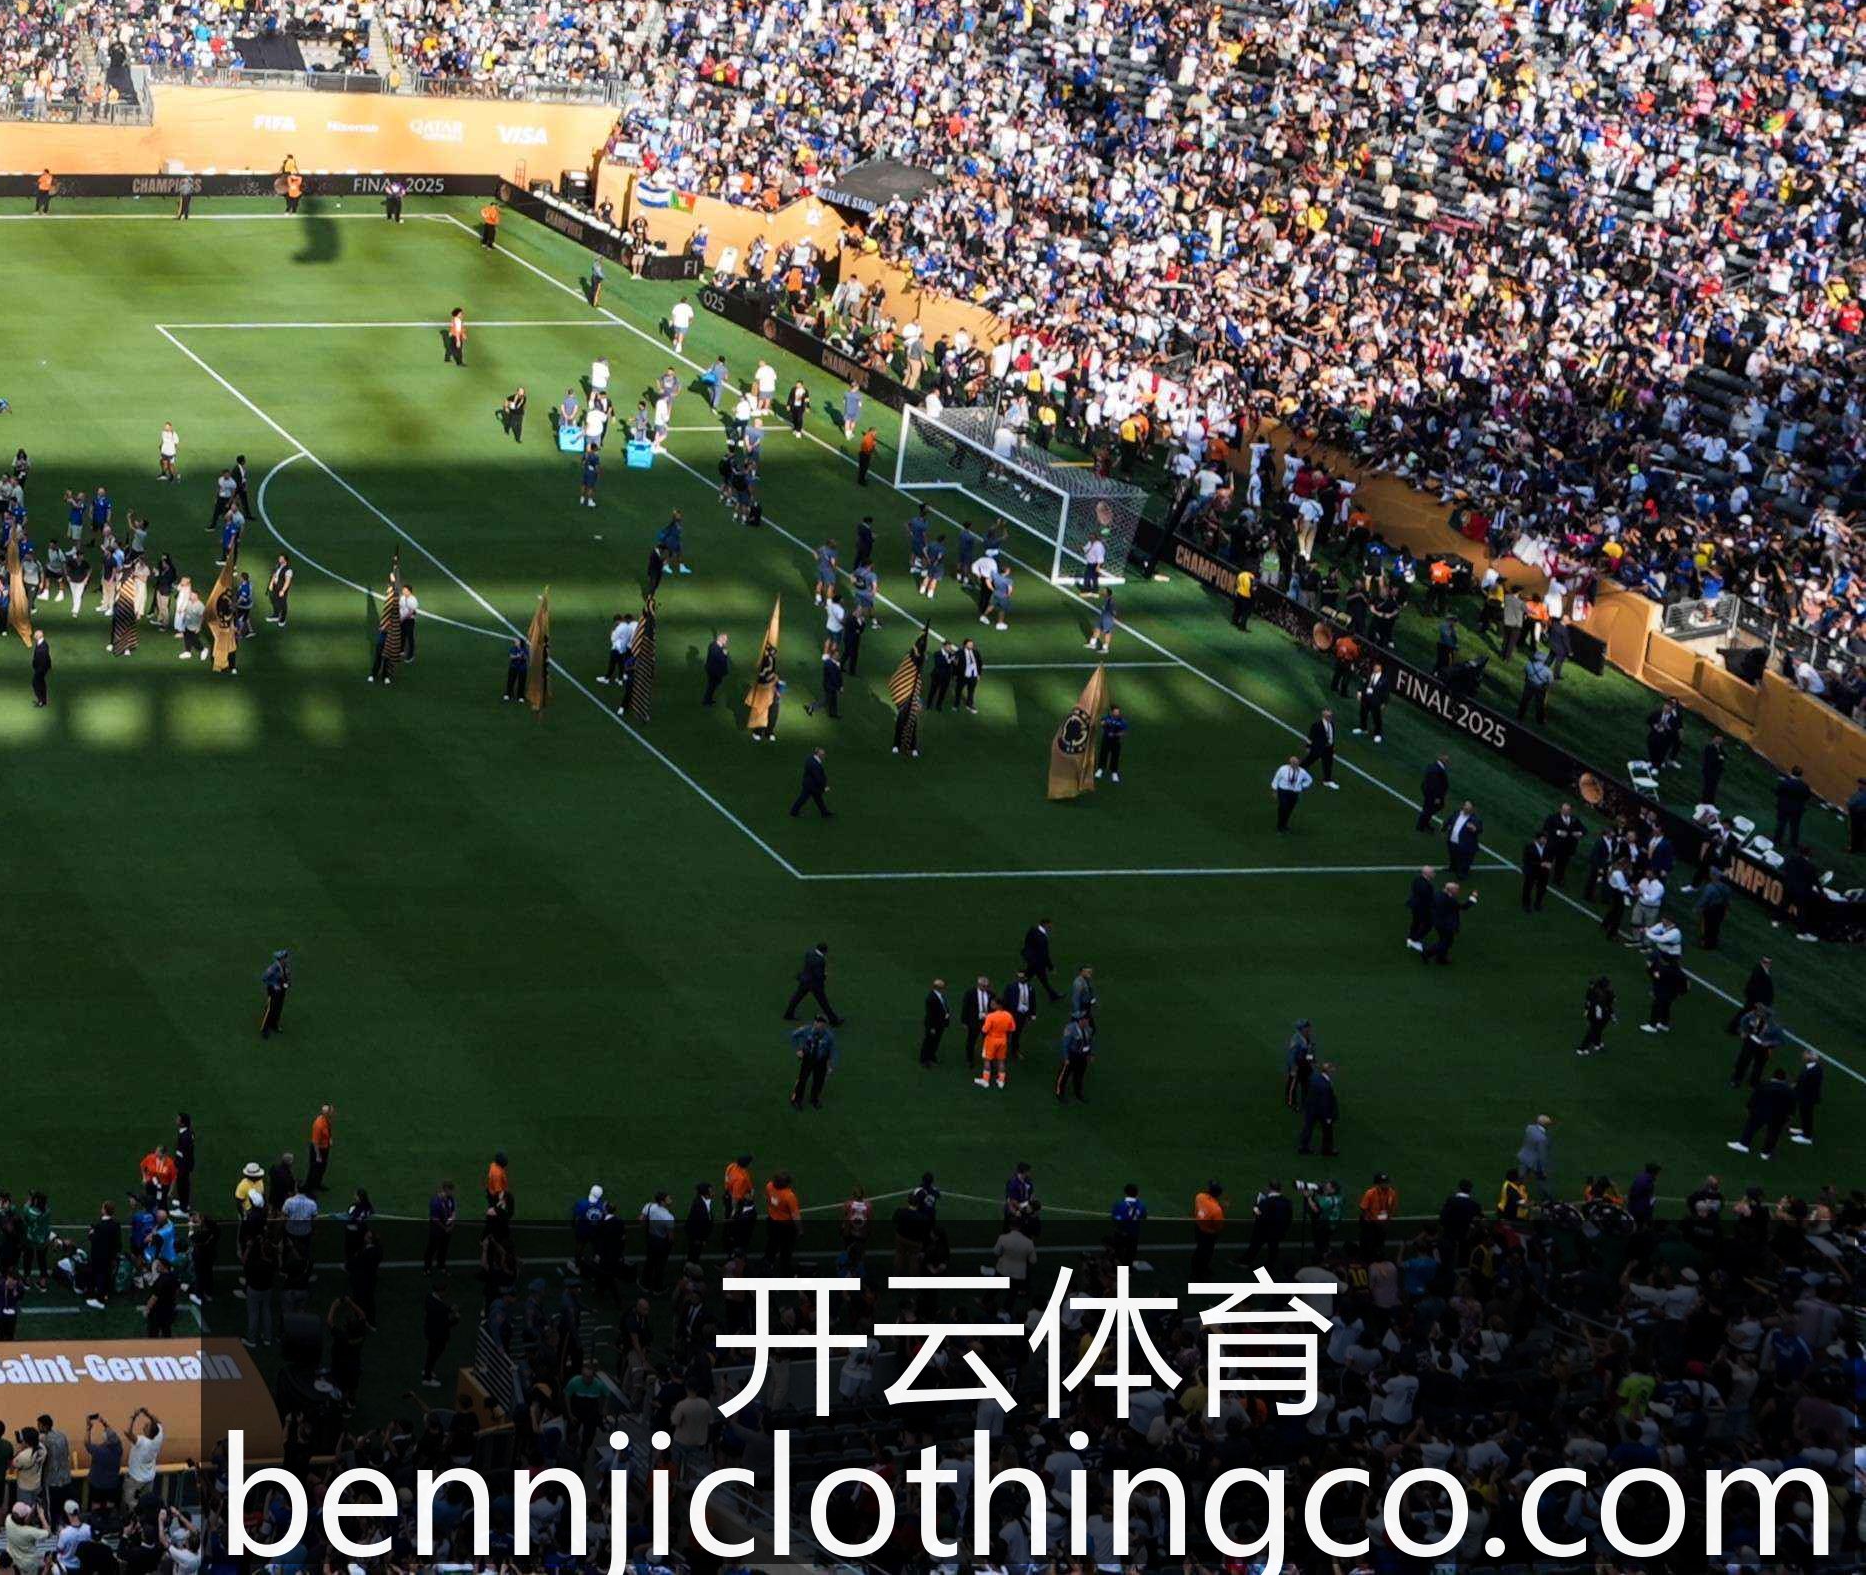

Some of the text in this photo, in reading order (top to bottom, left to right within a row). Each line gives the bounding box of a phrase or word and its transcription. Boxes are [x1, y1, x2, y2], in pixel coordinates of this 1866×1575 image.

[496, 122, 549, 145] VISA
[353, 178, 391, 193] FINA
[406, 178, 445, 193] 2025
[703, 289, 725, 313] 025
[1174, 543, 1238, 595] CHAMPION
[1395, 669, 1507, 749] FINAL 2025
